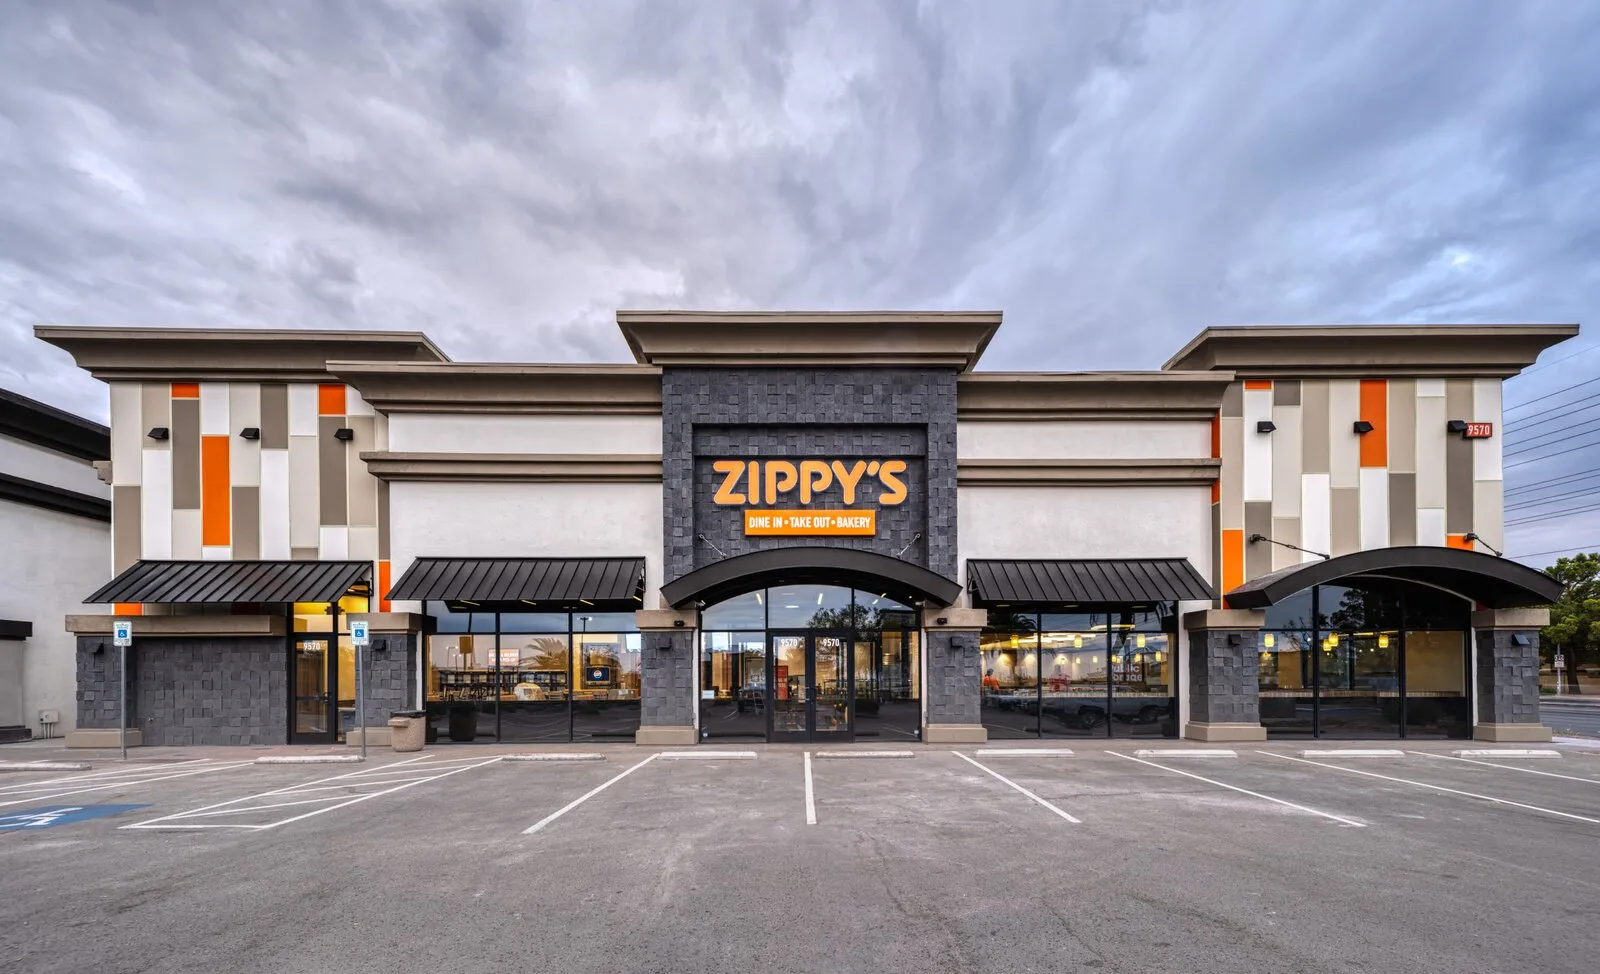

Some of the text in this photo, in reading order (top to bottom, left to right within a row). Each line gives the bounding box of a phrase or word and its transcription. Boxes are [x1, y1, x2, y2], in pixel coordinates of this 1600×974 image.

[1468, 425, 1490, 435] 9570
[713, 460, 907, 505] ZIPPY'S
[749, 517, 871, 528] DINE IN TAKE OUT BAKERY
[304, 642, 320, 650] 9570
